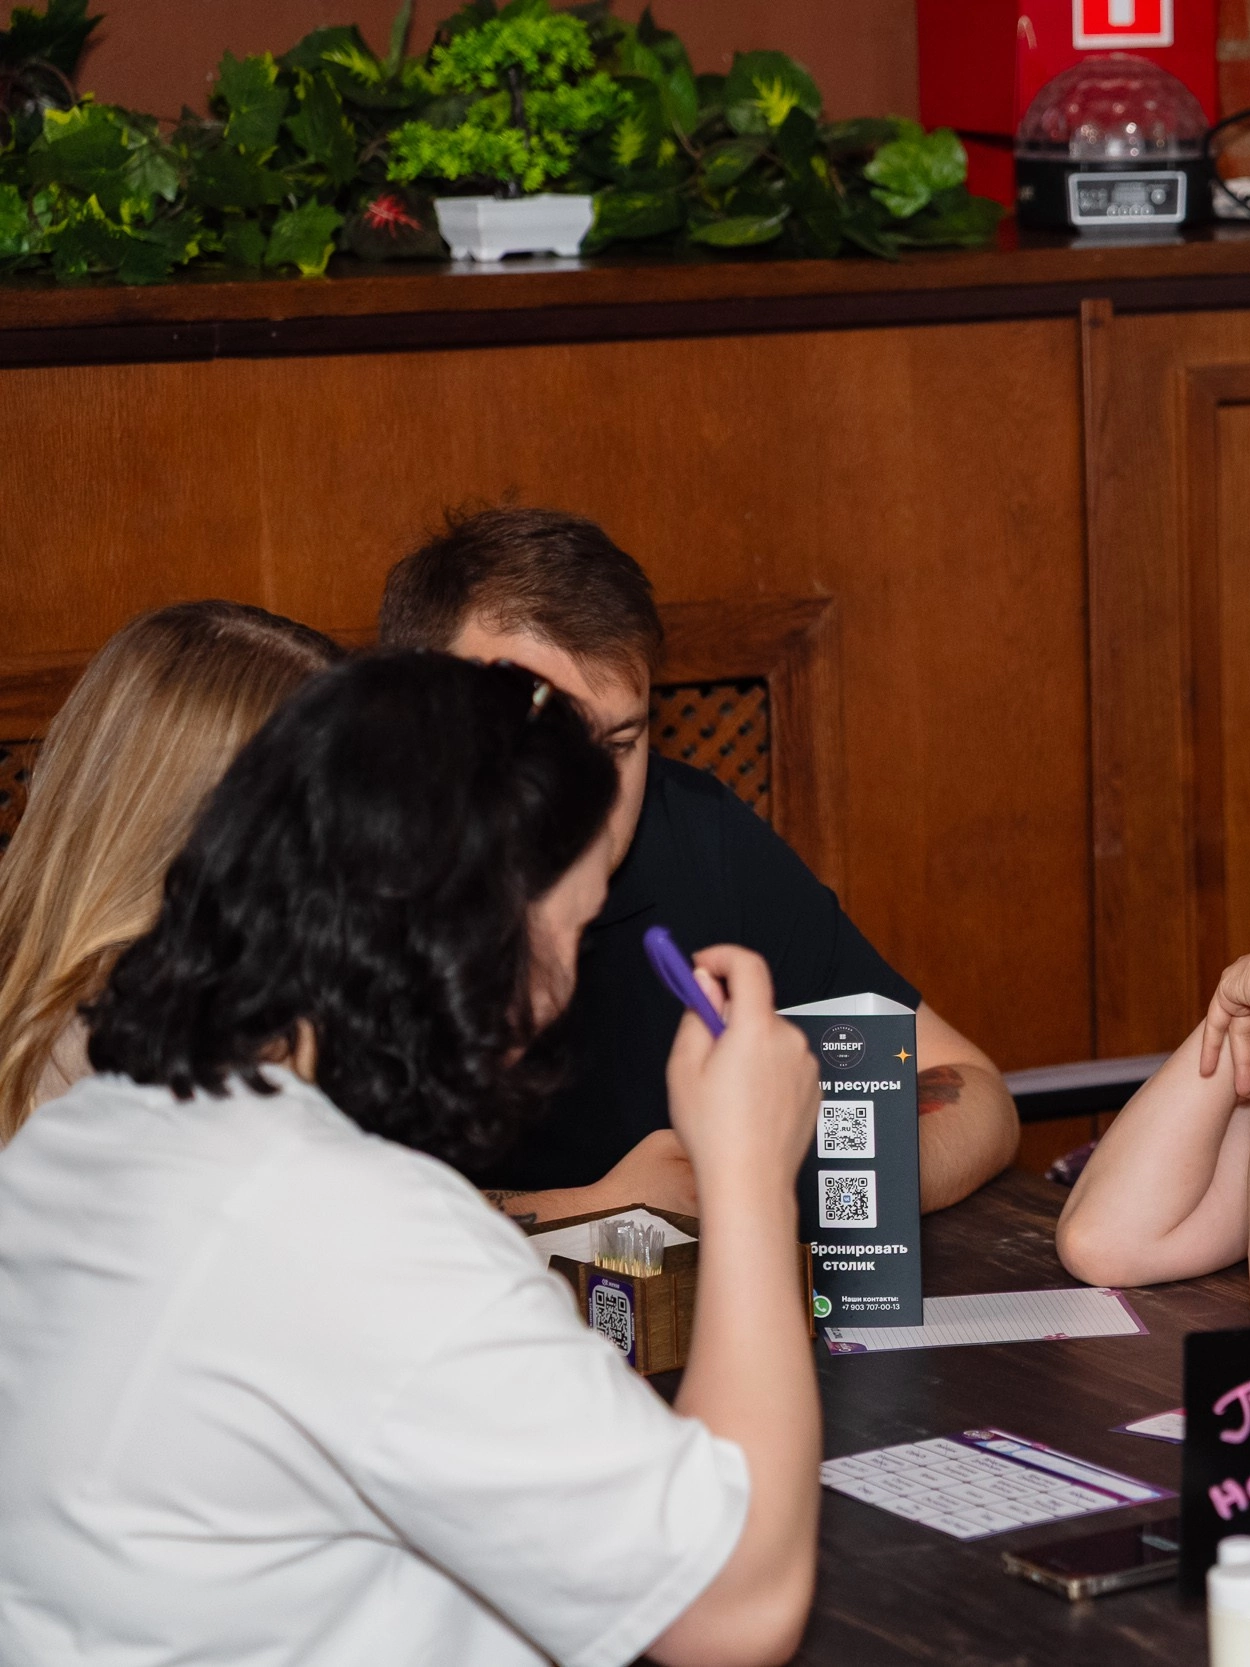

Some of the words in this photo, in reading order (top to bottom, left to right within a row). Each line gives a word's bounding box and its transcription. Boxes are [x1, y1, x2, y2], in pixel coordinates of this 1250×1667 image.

[822, 1042, 864, 1051] ЗОЛБЕРГ
[834, 1081, 901, 1093] ресурсы
[811, 1242, 908, 1256] бронировать
[822, 1261, 876, 1271] столик
[841, 1295, 862, 1303] Наши
[851, 1303, 864, 1311] 903
[866, 1303, 901, 1311] 707-00-13
